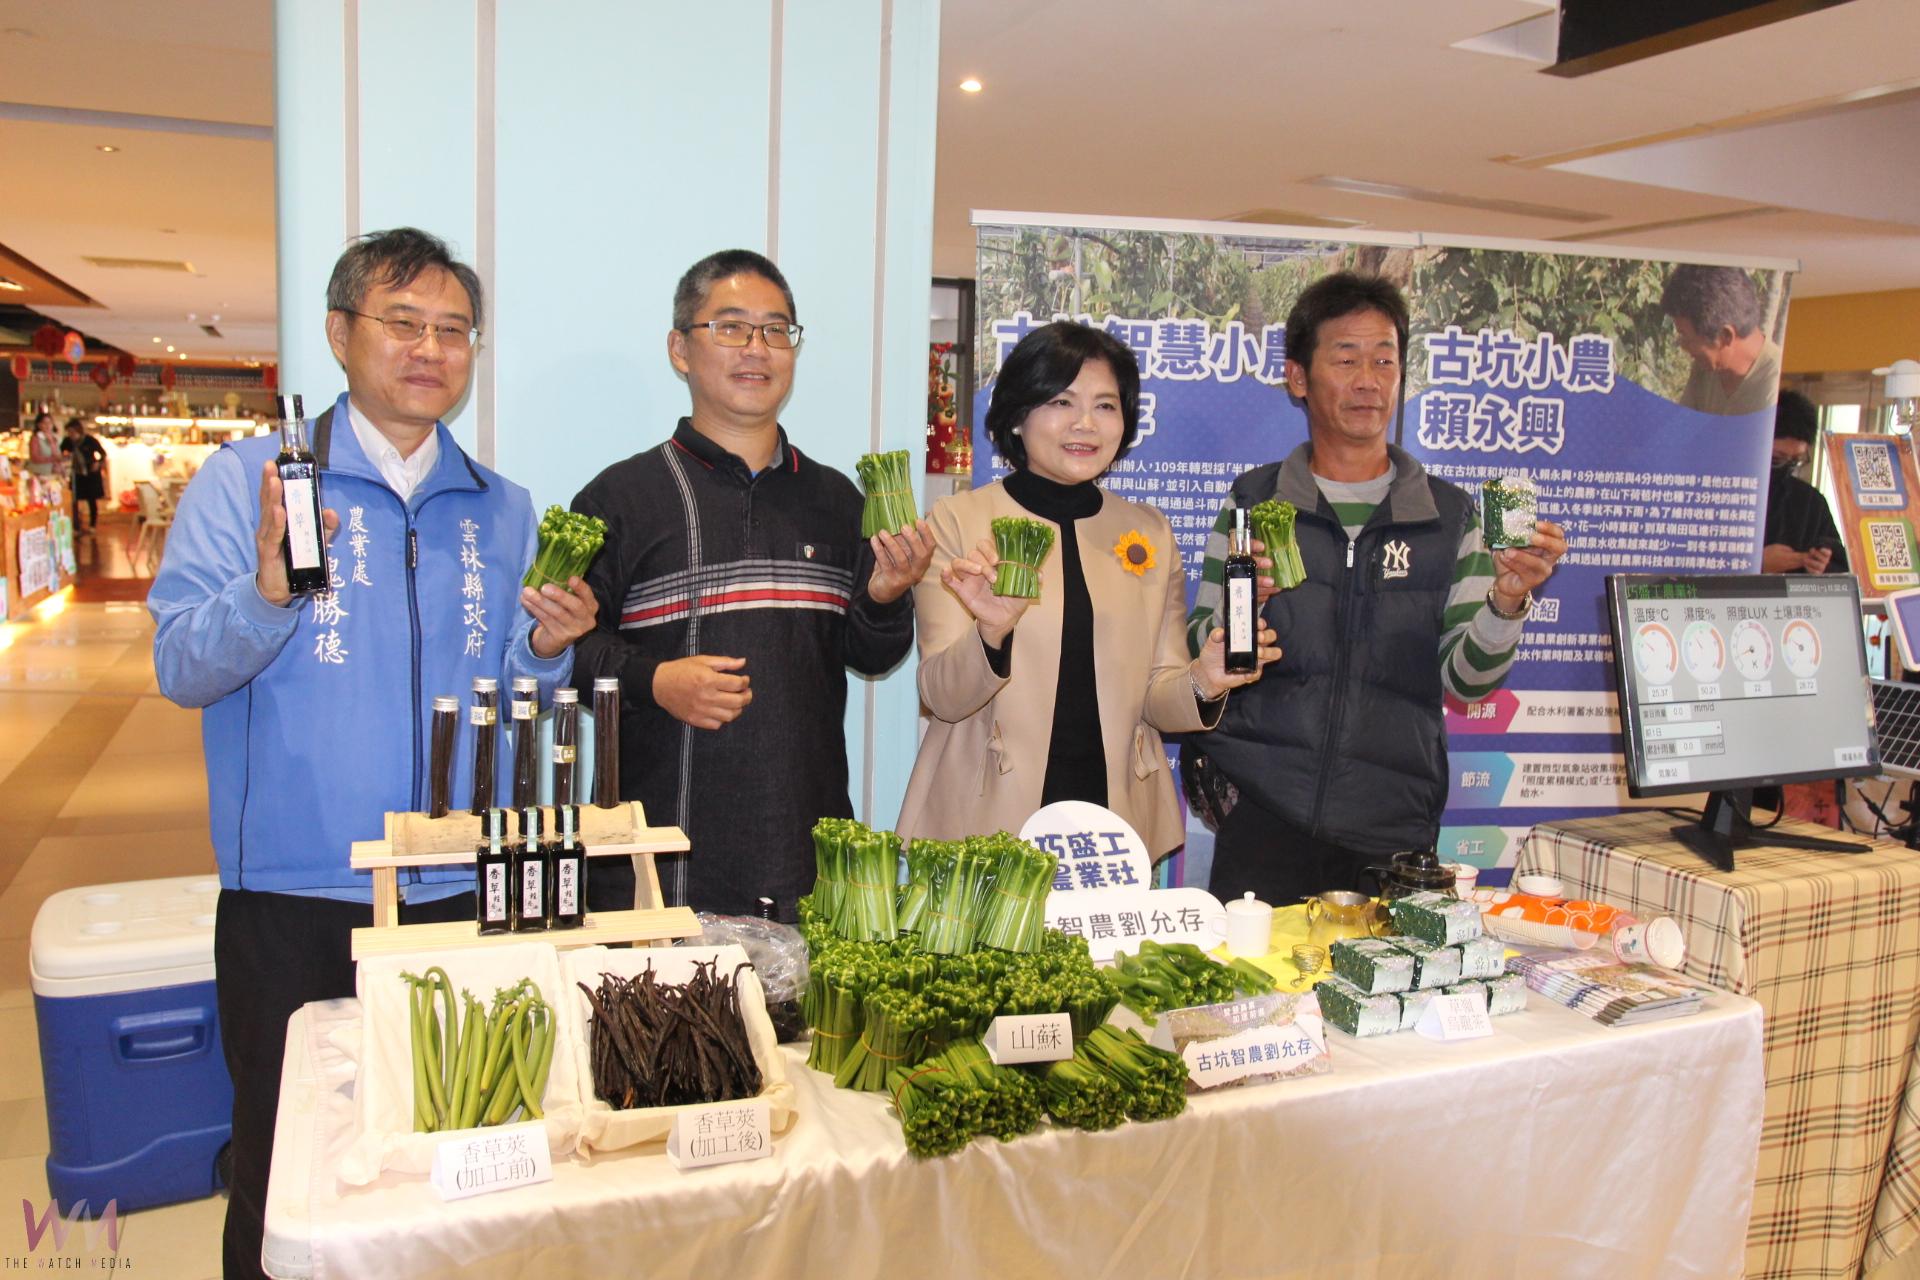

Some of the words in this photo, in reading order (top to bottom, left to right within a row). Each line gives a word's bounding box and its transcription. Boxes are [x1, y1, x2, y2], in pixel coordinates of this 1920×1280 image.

[1428, 328, 1613, 391] 古坑小農
[1420, 393, 1563, 451] 賴永興
[349, 506, 373, 586] 農業處
[459, 518, 488, 658] 雲林縣政府
[1694, 703, 1715, 713] mm/d
[1461, 771, 1491, 788] 節流
[1035, 831, 1131, 860] 巧盛工
[1456, 839, 1485, 856] 省工
[1012, 1024, 1062, 1051] 山蘇
[1196, 1037, 1313, 1073] 古坑智農劉允存
[694, 1107, 757, 1136] 香草莢
[462, 1134, 527, 1165] 香草莢
[690, 1131, 763, 1160] (加工後)
[456, 1157, 536, 1191] (加工前)
